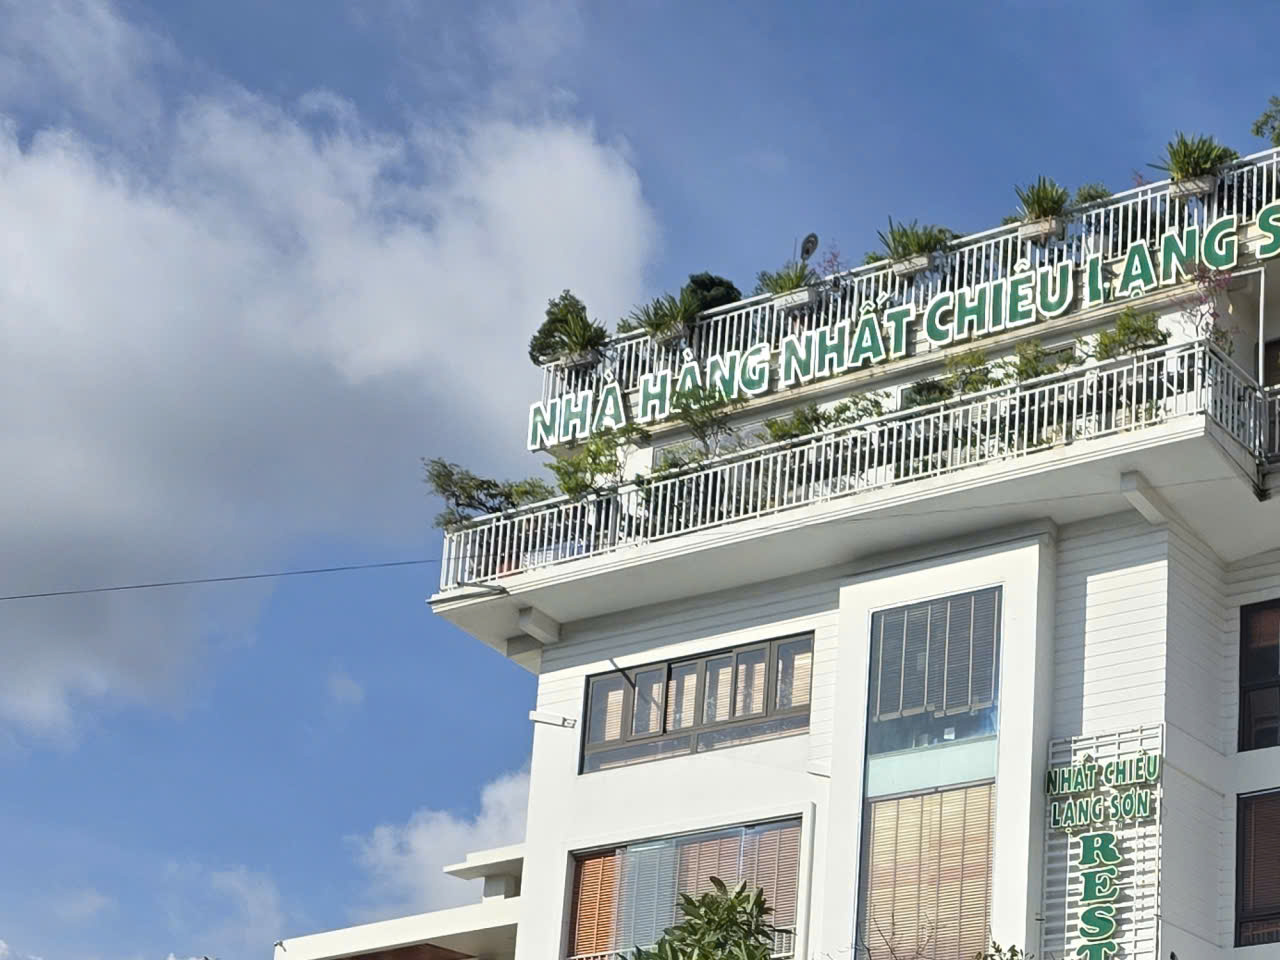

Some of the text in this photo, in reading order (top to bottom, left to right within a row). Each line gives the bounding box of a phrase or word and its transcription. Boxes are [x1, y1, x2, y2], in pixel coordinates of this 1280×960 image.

[527, 368, 628, 452] NHÀ
[634, 342, 770, 424] HÀNG
[778, 290, 917, 387] NHẤT
[1045, 752, 1098, 795] NHẤT
[1050, 787, 1151, 834] LẠNG SƠN
